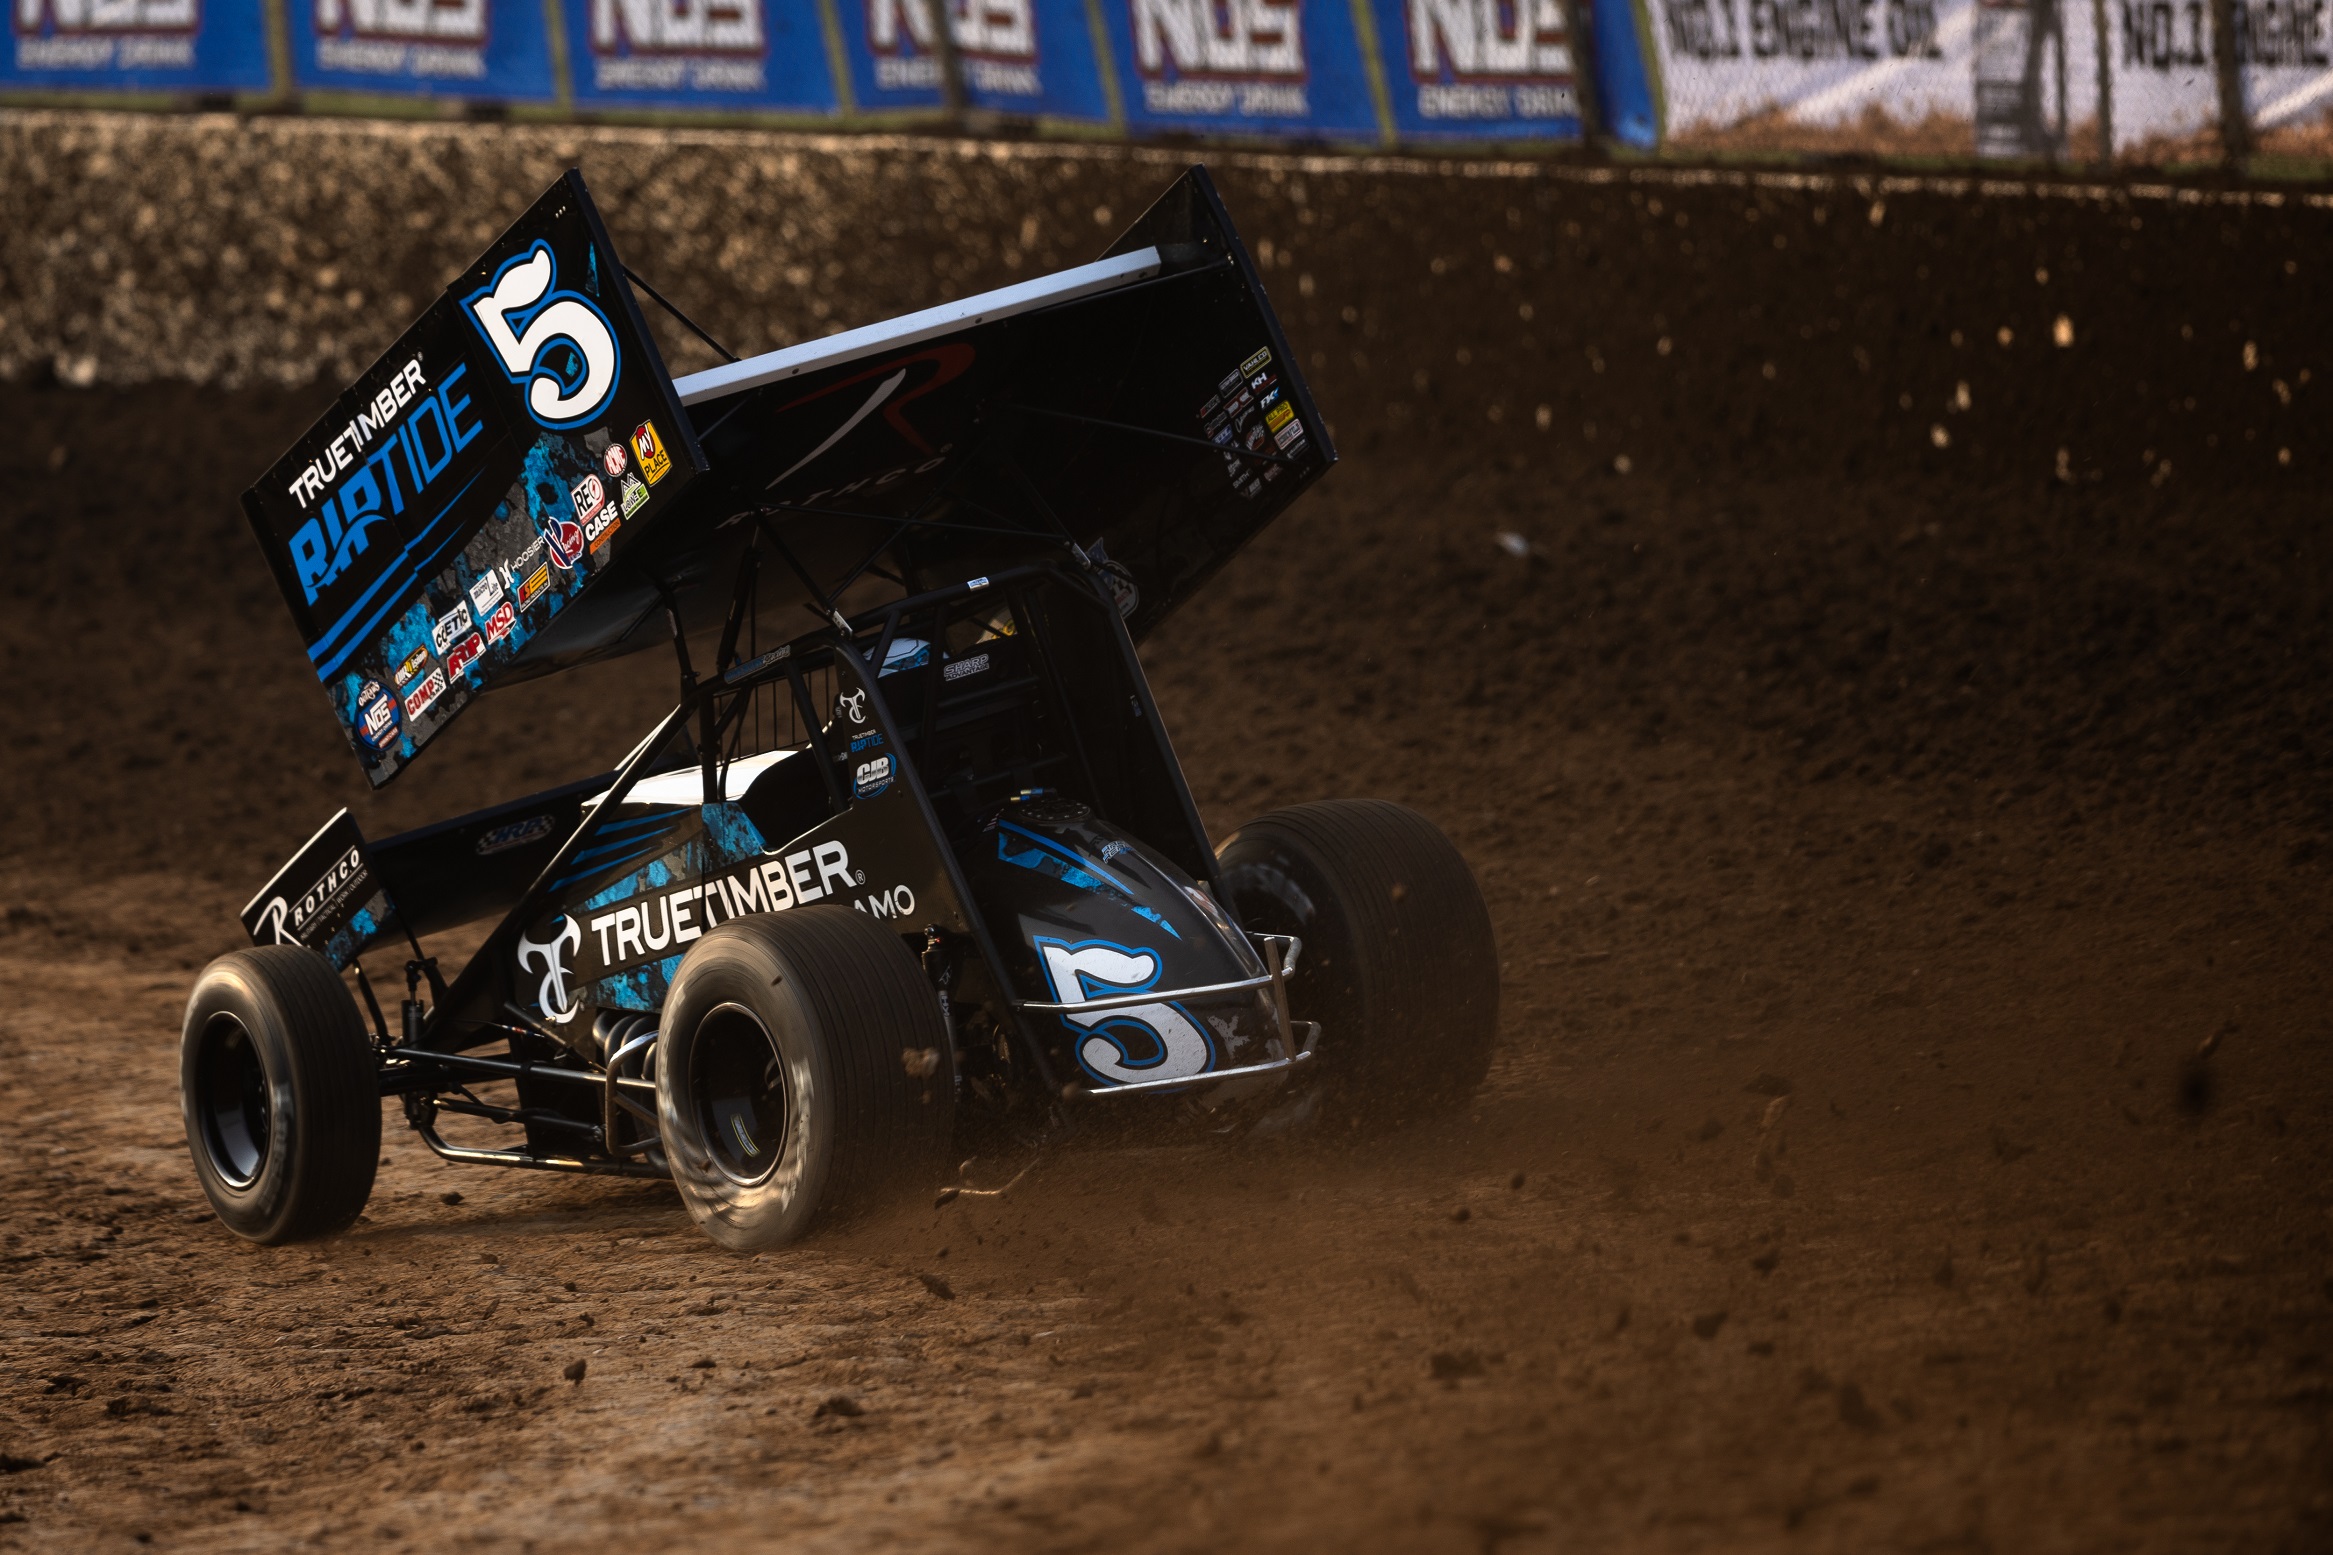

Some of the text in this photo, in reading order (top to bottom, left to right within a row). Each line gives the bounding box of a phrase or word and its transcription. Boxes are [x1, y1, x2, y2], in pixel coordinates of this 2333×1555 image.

[459, 239, 620, 429] 5
[288, 361, 484, 607] RIPTIDE
[644, 450, 668, 478] PLACE
[585, 501, 618, 542] CASE
[511, 536, 545, 572] HOOSIER
[485, 603, 513, 642] MSD
[944, 655, 989, 675] SHARP
[364, 693, 392, 736] NOS
[406, 678, 435, 716] COMP
[294, 849, 360, 927] ROTHCO
[1036, 936, 1214, 1091] 5
